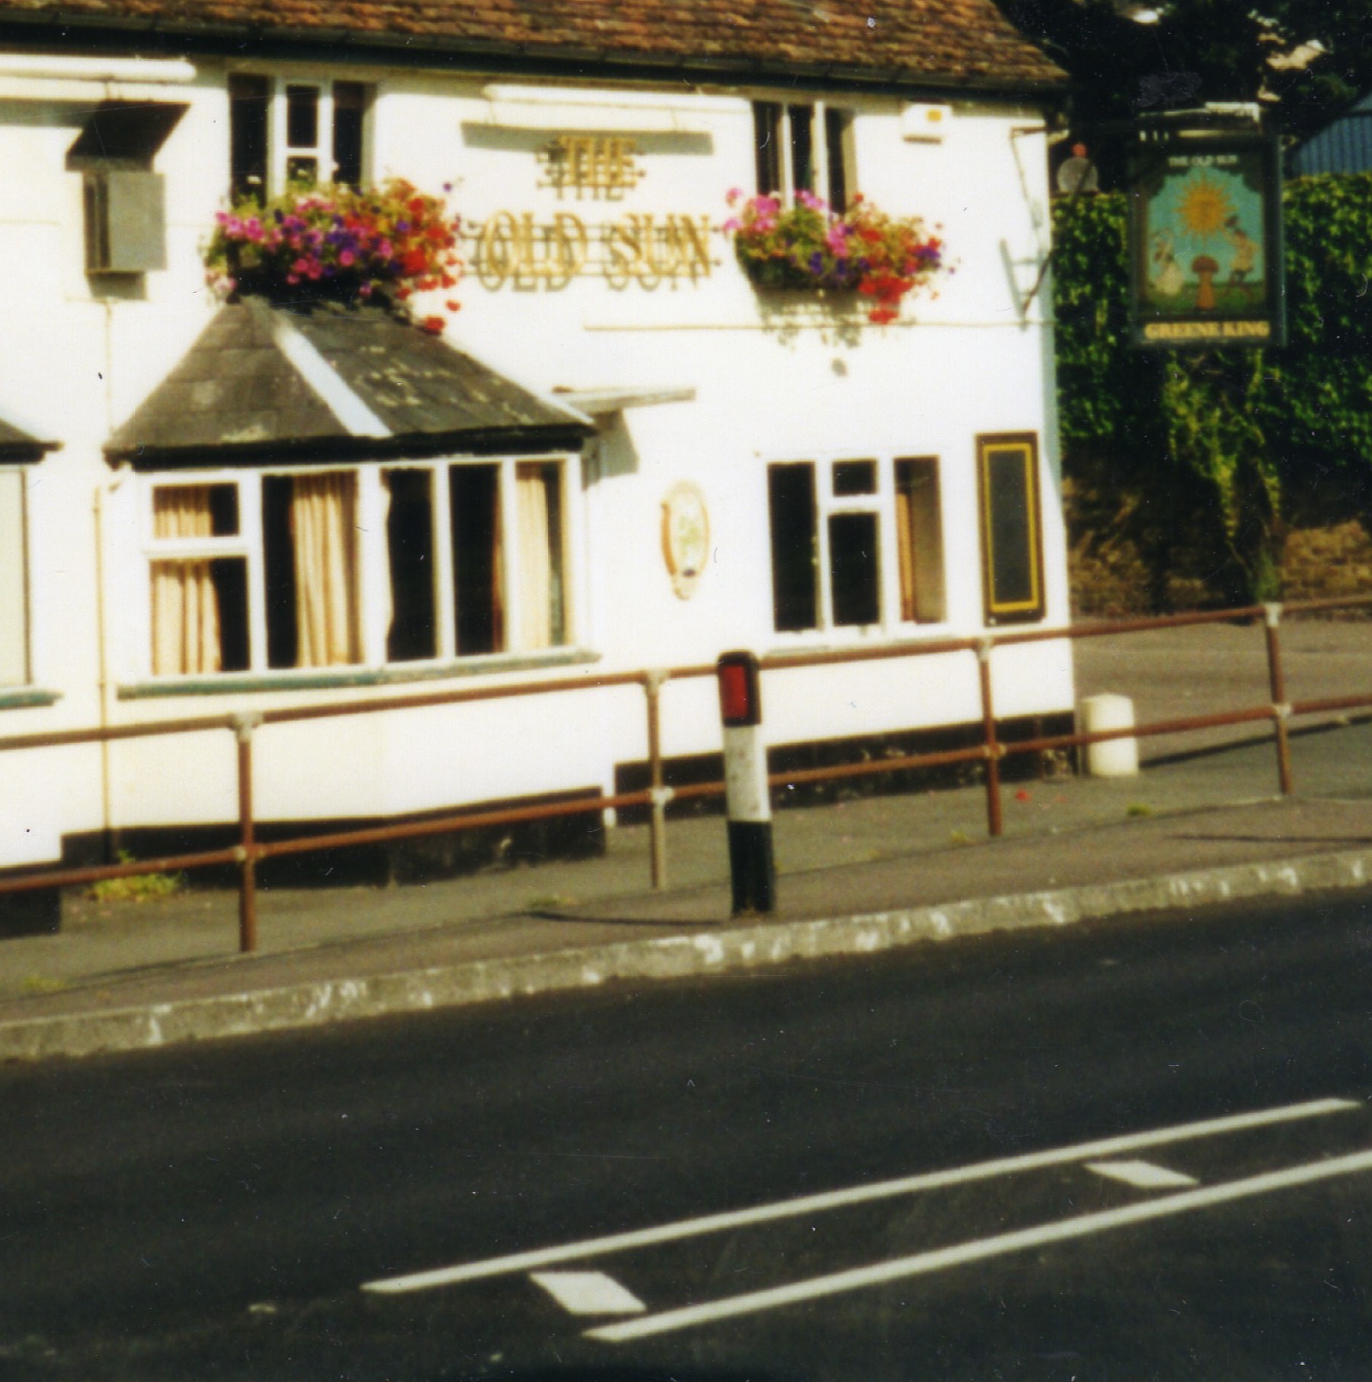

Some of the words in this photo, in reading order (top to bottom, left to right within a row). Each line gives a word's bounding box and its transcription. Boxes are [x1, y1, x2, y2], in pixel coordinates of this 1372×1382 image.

[558, 135, 636, 189] THE
[482, 210, 588, 278] OLD
[609, 212, 711, 278] SUN
